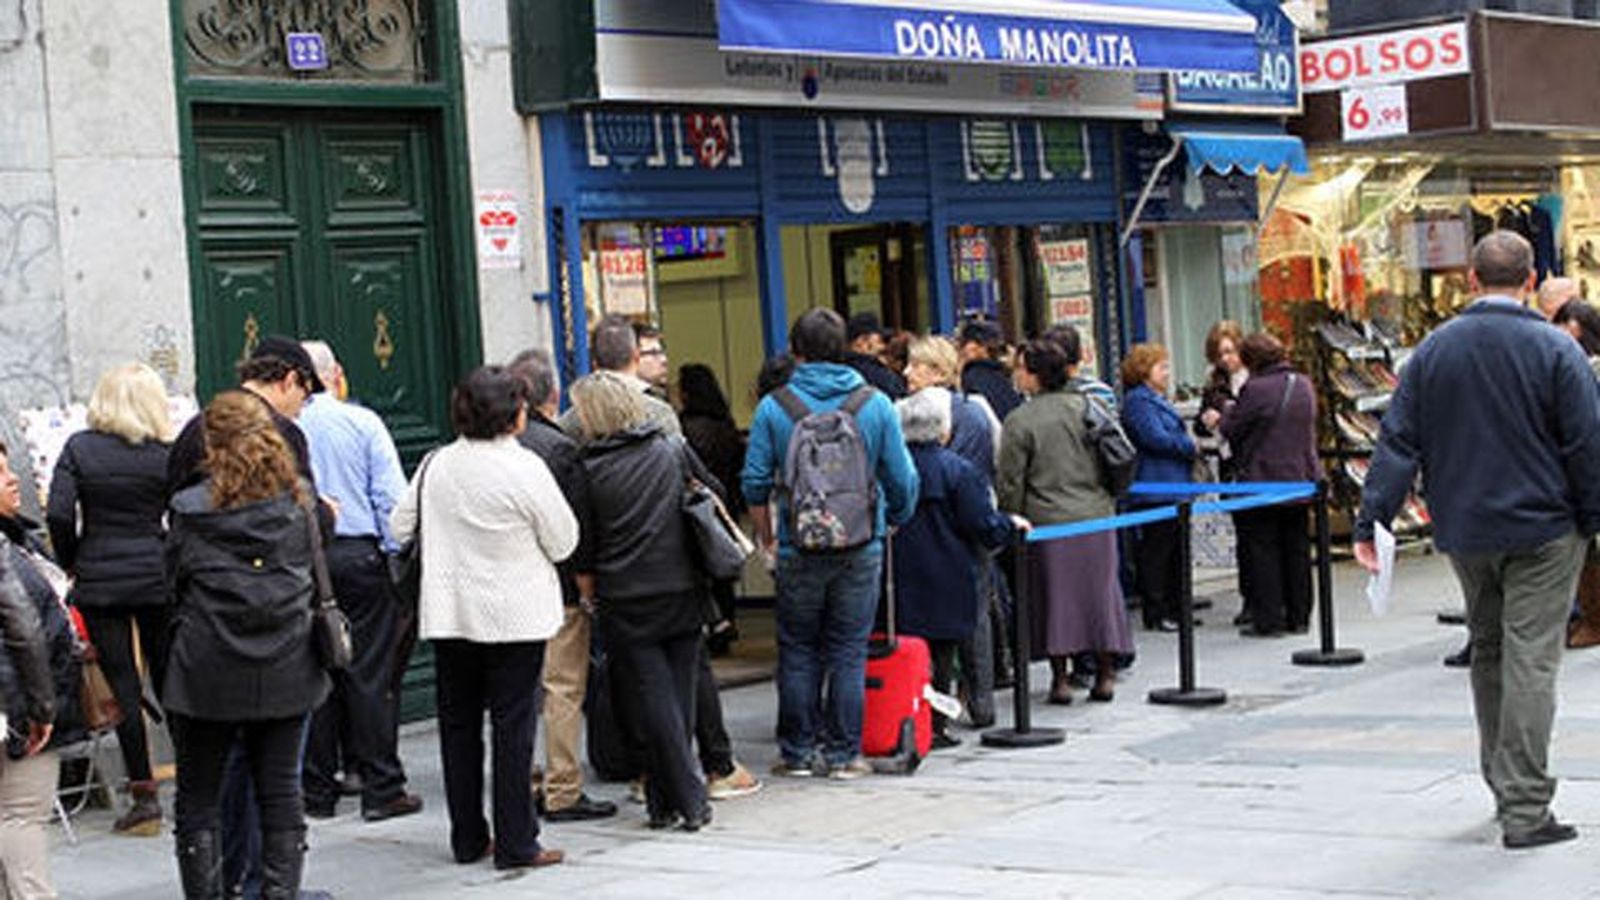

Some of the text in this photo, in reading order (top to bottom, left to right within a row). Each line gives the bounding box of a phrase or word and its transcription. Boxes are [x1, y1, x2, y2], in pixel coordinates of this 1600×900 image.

[894, 15, 1138, 67] DOÑA MANOLITA
[1301, 31, 1462, 84] BOLSOS
